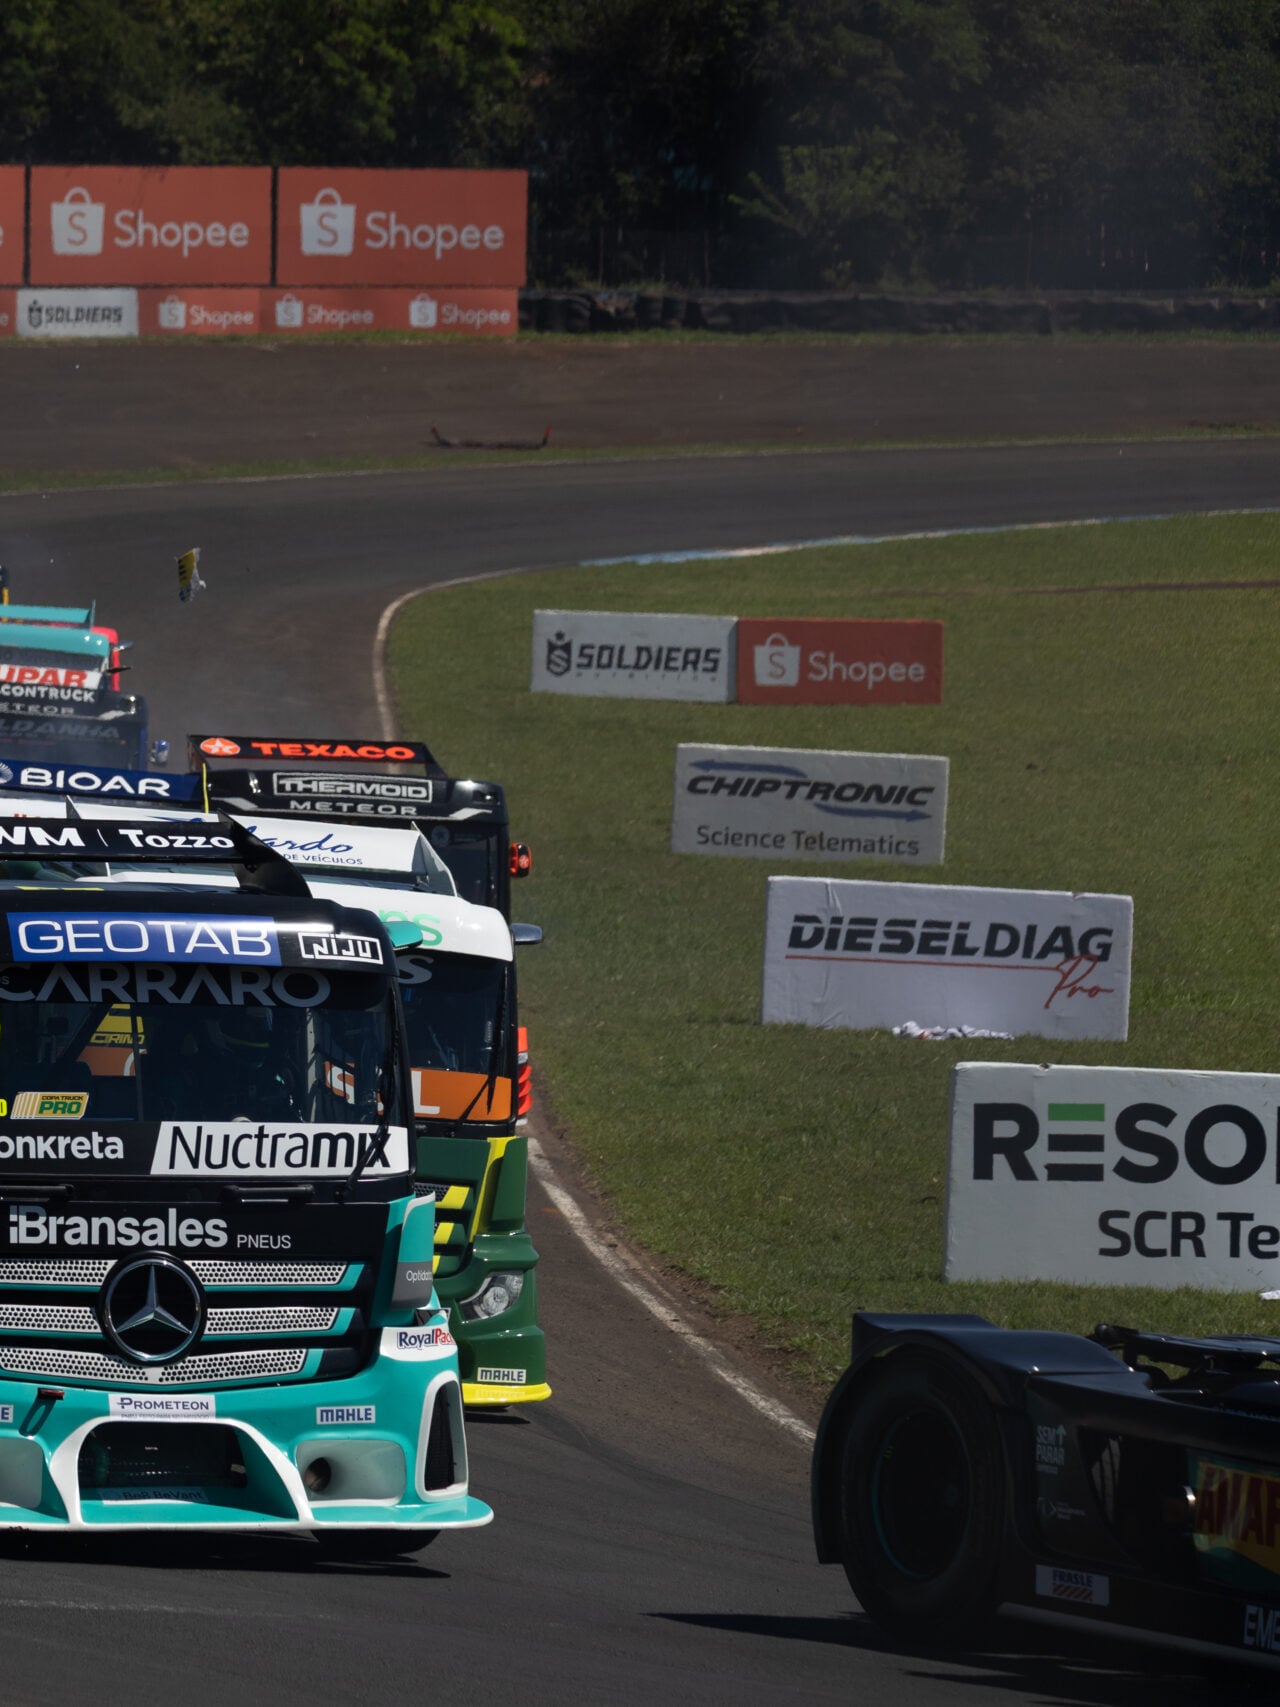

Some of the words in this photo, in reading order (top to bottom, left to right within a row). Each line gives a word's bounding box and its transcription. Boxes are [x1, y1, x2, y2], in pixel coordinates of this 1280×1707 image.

[114, 209, 249, 257] Shopee
[365, 211, 505, 260] Shopee
[43, 304, 123, 325] SOLDIERS
[190, 306, 255, 330] Shopee
[306, 305, 375, 329] Shopee
[441, 305, 511, 329] Shopee
[576, 643, 722, 674] SOLDIERS
[807, 650, 926, 690] Shopee
[250, 741, 416, 760] TEXACO
[20, 766, 170, 797] BIOAR
[277, 776, 427, 800] THERMOID
[686, 773, 936, 807] CHIPTRONIC
[289, 799, 417, 816] METEOR
[696, 825, 786, 851] Science
[791, 829, 920, 858] Telematics
[297, 853, 364, 866] VEÍCULOS
[18, 920, 273, 958] GEOTAB
[787, 912, 1114, 962] DIESELDIAG
[1044, 954, 1115, 1009] Pro
[37, 1100, 83, 1115] PRO
[170, 1125, 392, 1171] Nuctramix
[972, 1102, 1280, 1186] RESO
[236, 1234, 292, 1249] PNEUS
[1098, 1209, 1207, 1259] SCR
[480, 1368, 524, 1382] MAHLE
[117, 1396, 209, 1411] PROMETEON
[320, 1406, 373, 1424] MAHLE
[1036, 1425, 1057, 1445] SEM
